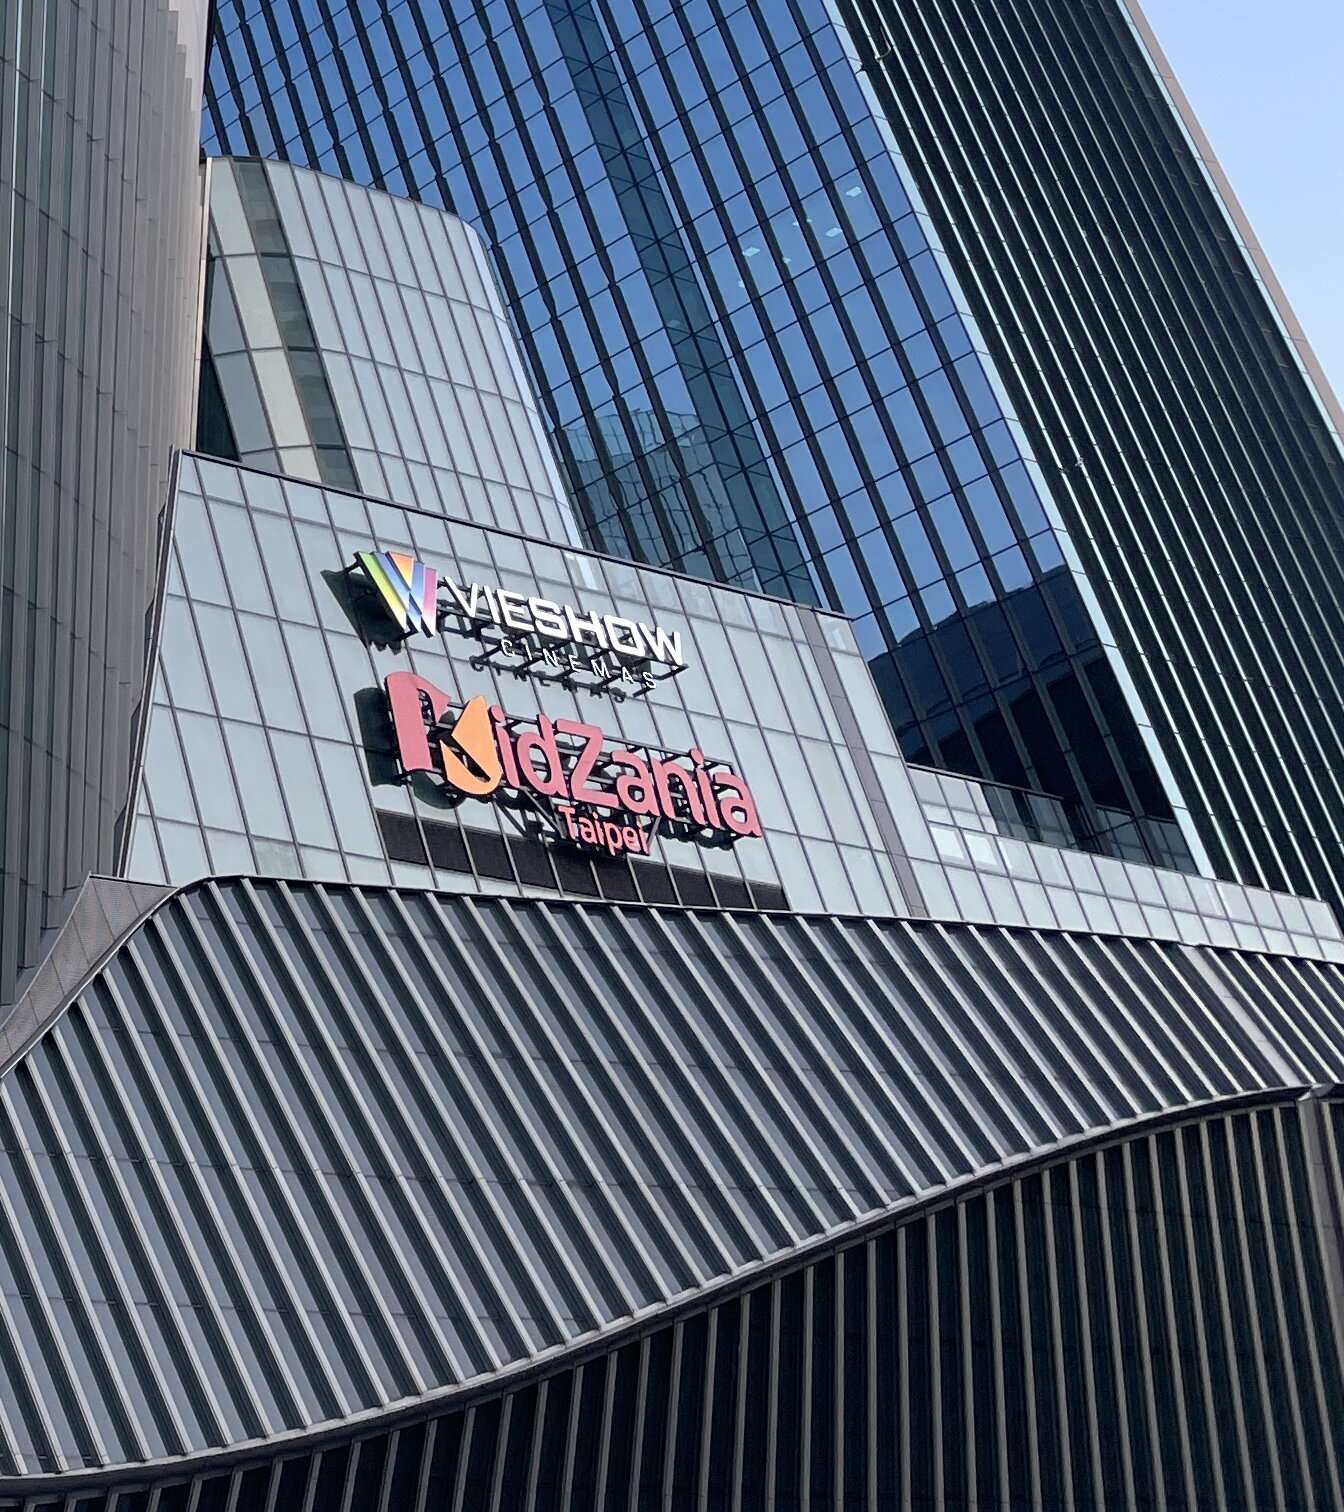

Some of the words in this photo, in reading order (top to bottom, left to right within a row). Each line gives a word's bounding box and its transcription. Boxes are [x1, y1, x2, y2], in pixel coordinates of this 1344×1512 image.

[443, 575, 683, 666] VIESHOW
[501, 638, 658, 690] CINEMAS
[385, 670, 763, 838] KidZania
[557, 805, 651, 857] Taipei
